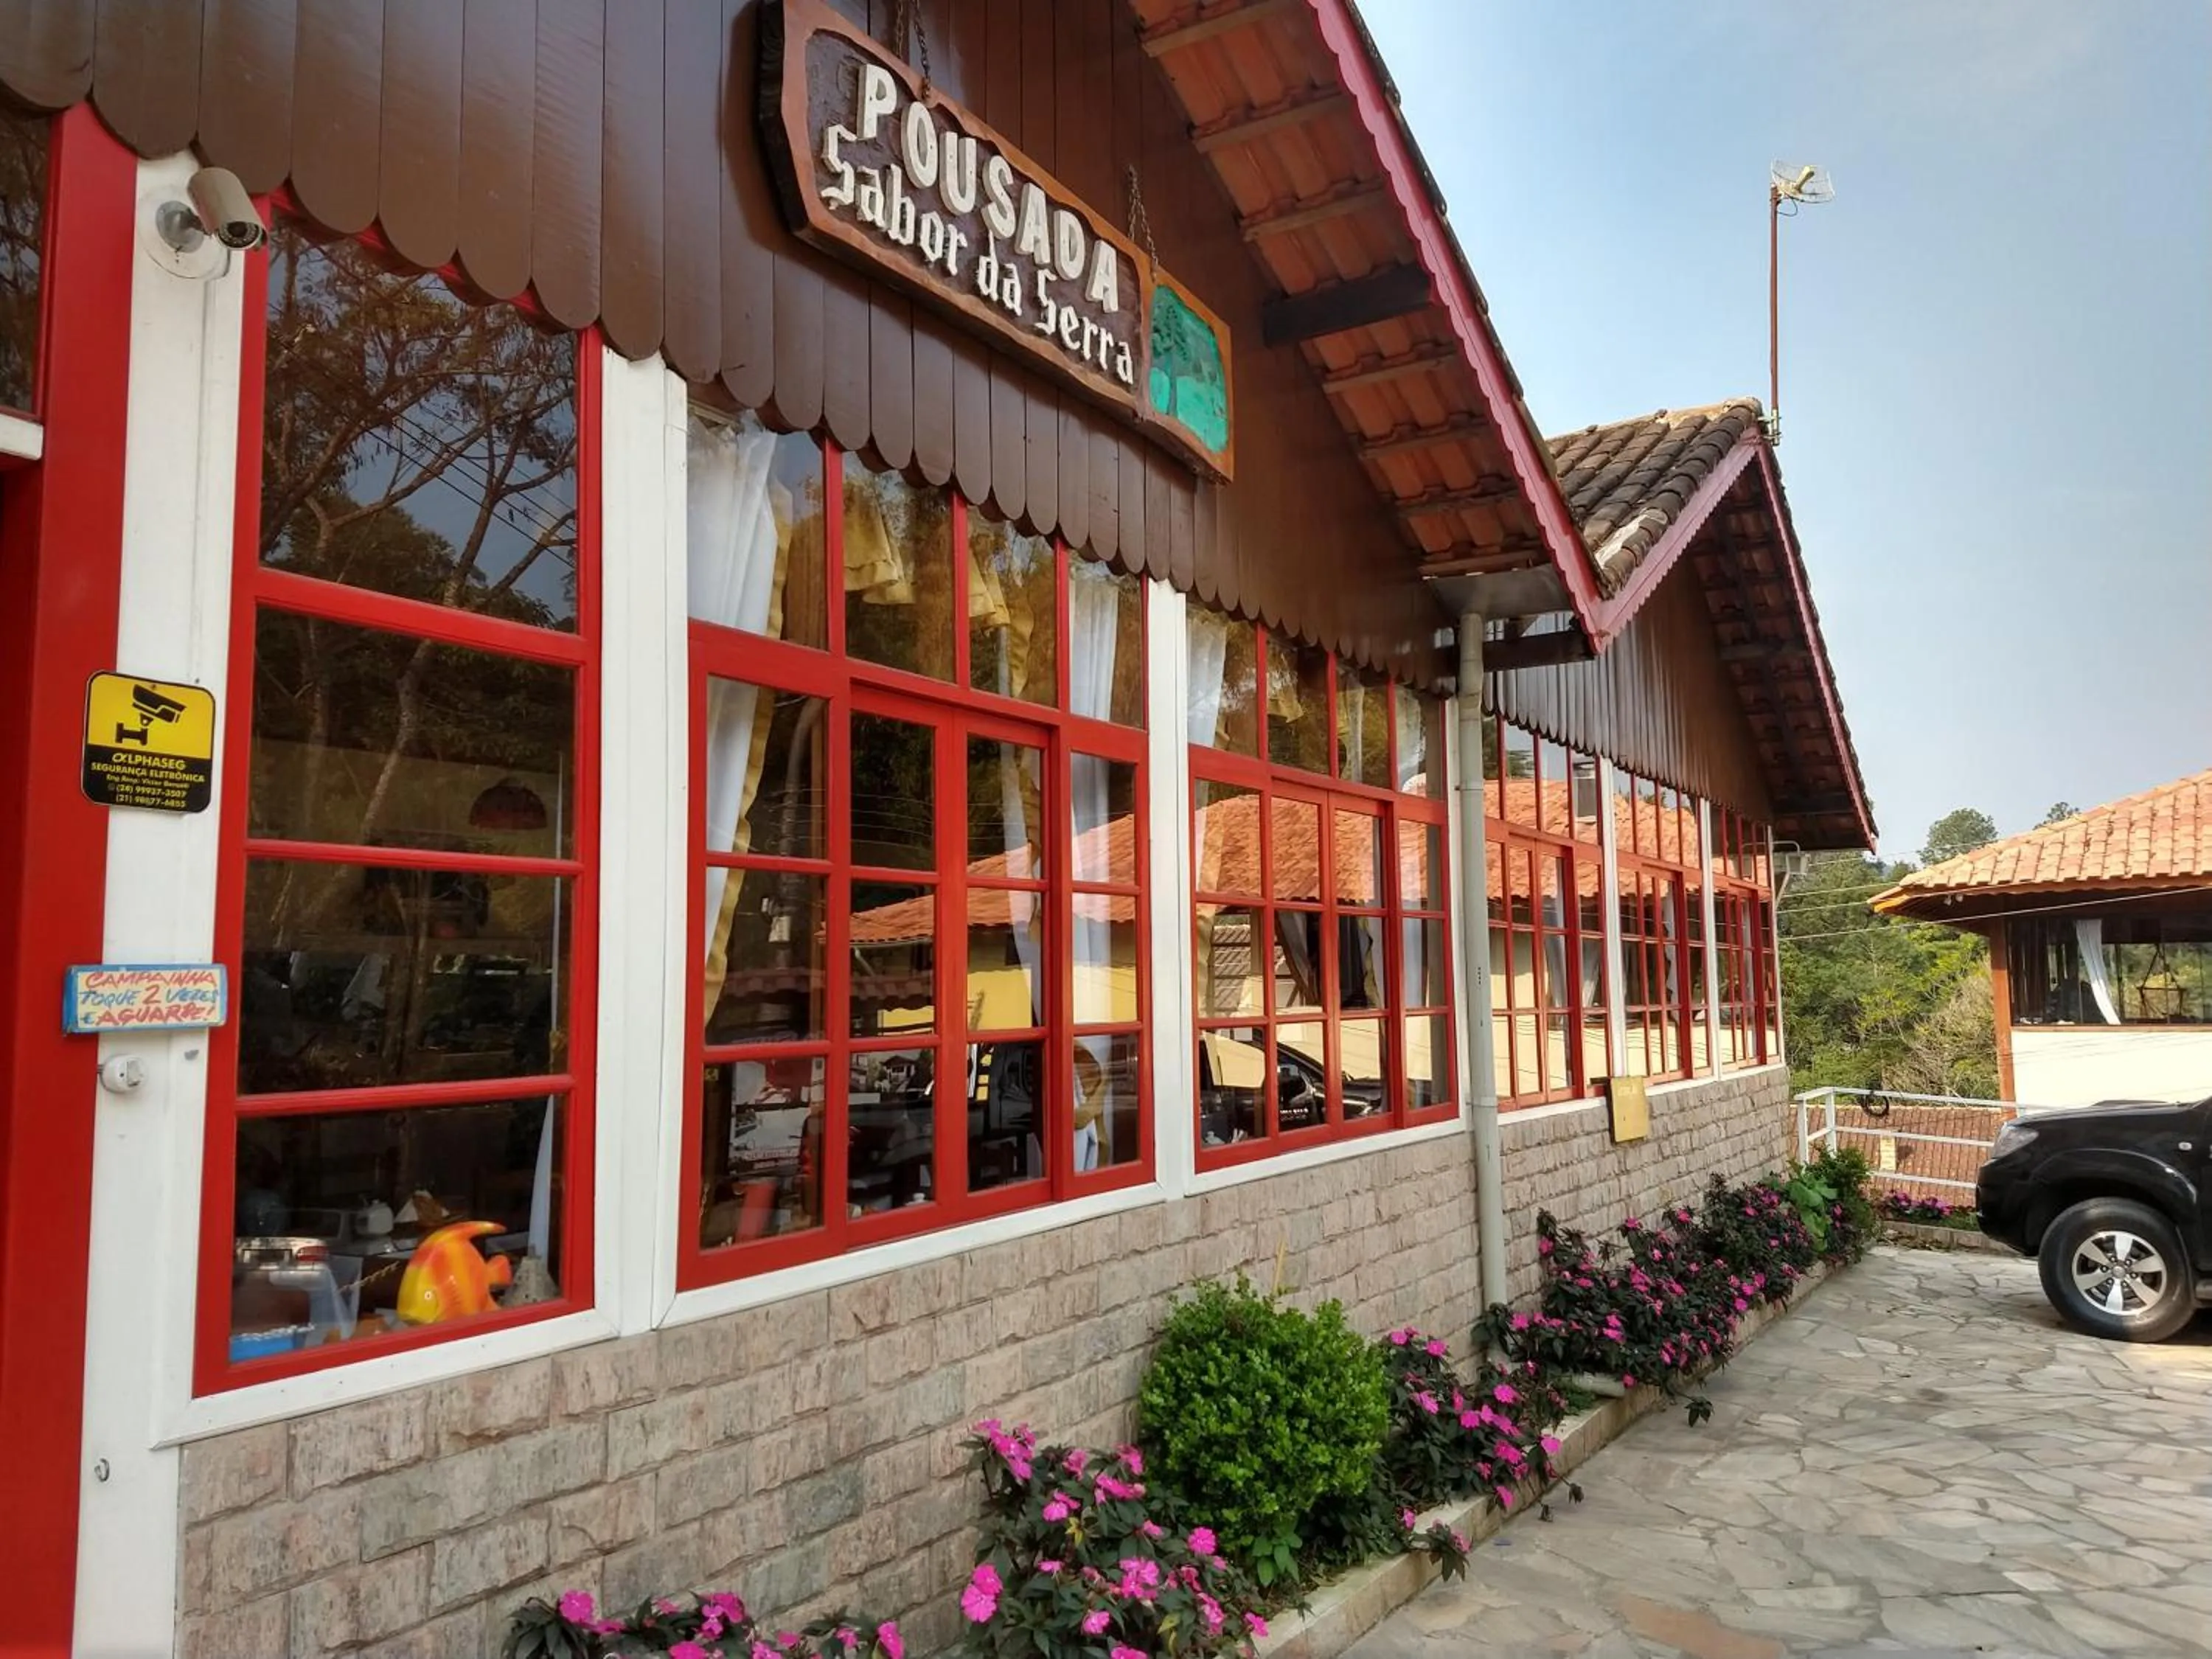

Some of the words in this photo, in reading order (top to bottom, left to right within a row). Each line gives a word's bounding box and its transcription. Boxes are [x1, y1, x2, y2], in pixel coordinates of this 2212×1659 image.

[821, 123, 969, 277] Sabor
[976, 229, 1023, 316] da
[1034, 268, 1134, 384] Serra
[857, 63, 1119, 313] POUSADA
[91, 762, 147, 778] SEGURANÇA
[149, 768, 206, 783] ELETRÔNICA
[142, 984, 161, 1004] 2
